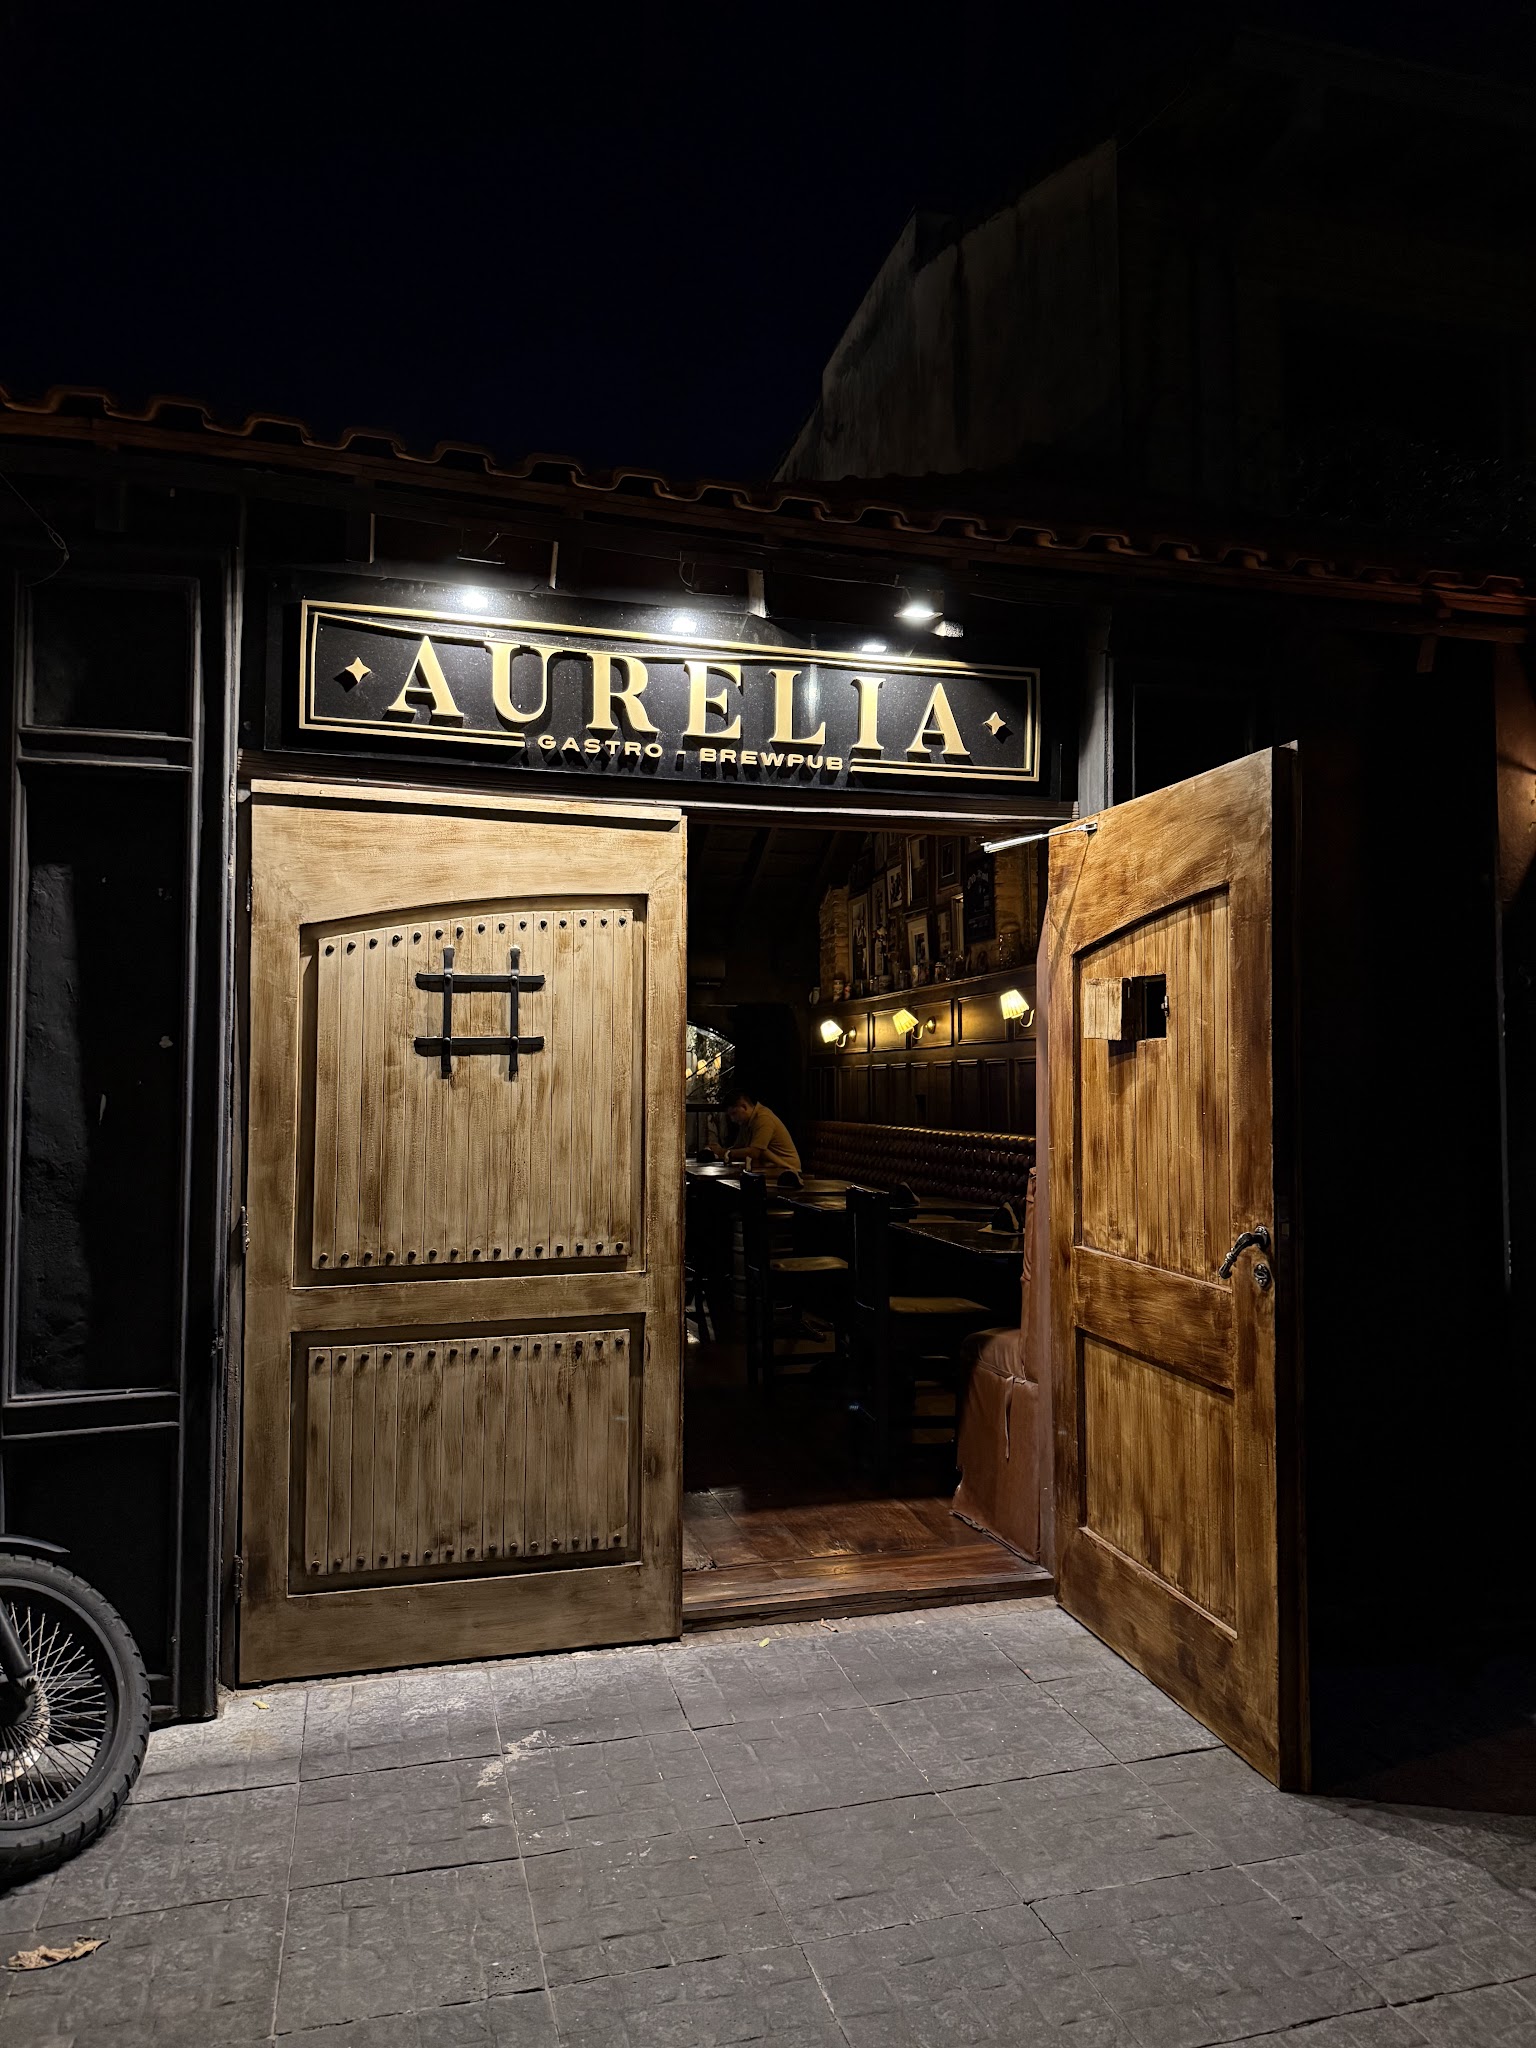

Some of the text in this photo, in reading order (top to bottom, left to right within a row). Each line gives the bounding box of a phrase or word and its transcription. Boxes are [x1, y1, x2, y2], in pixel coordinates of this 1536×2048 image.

[388, 634, 971, 757] AURELIA
[537, 734, 663, 758] GASTRO
[699, 747, 843, 771] BREWPUB
